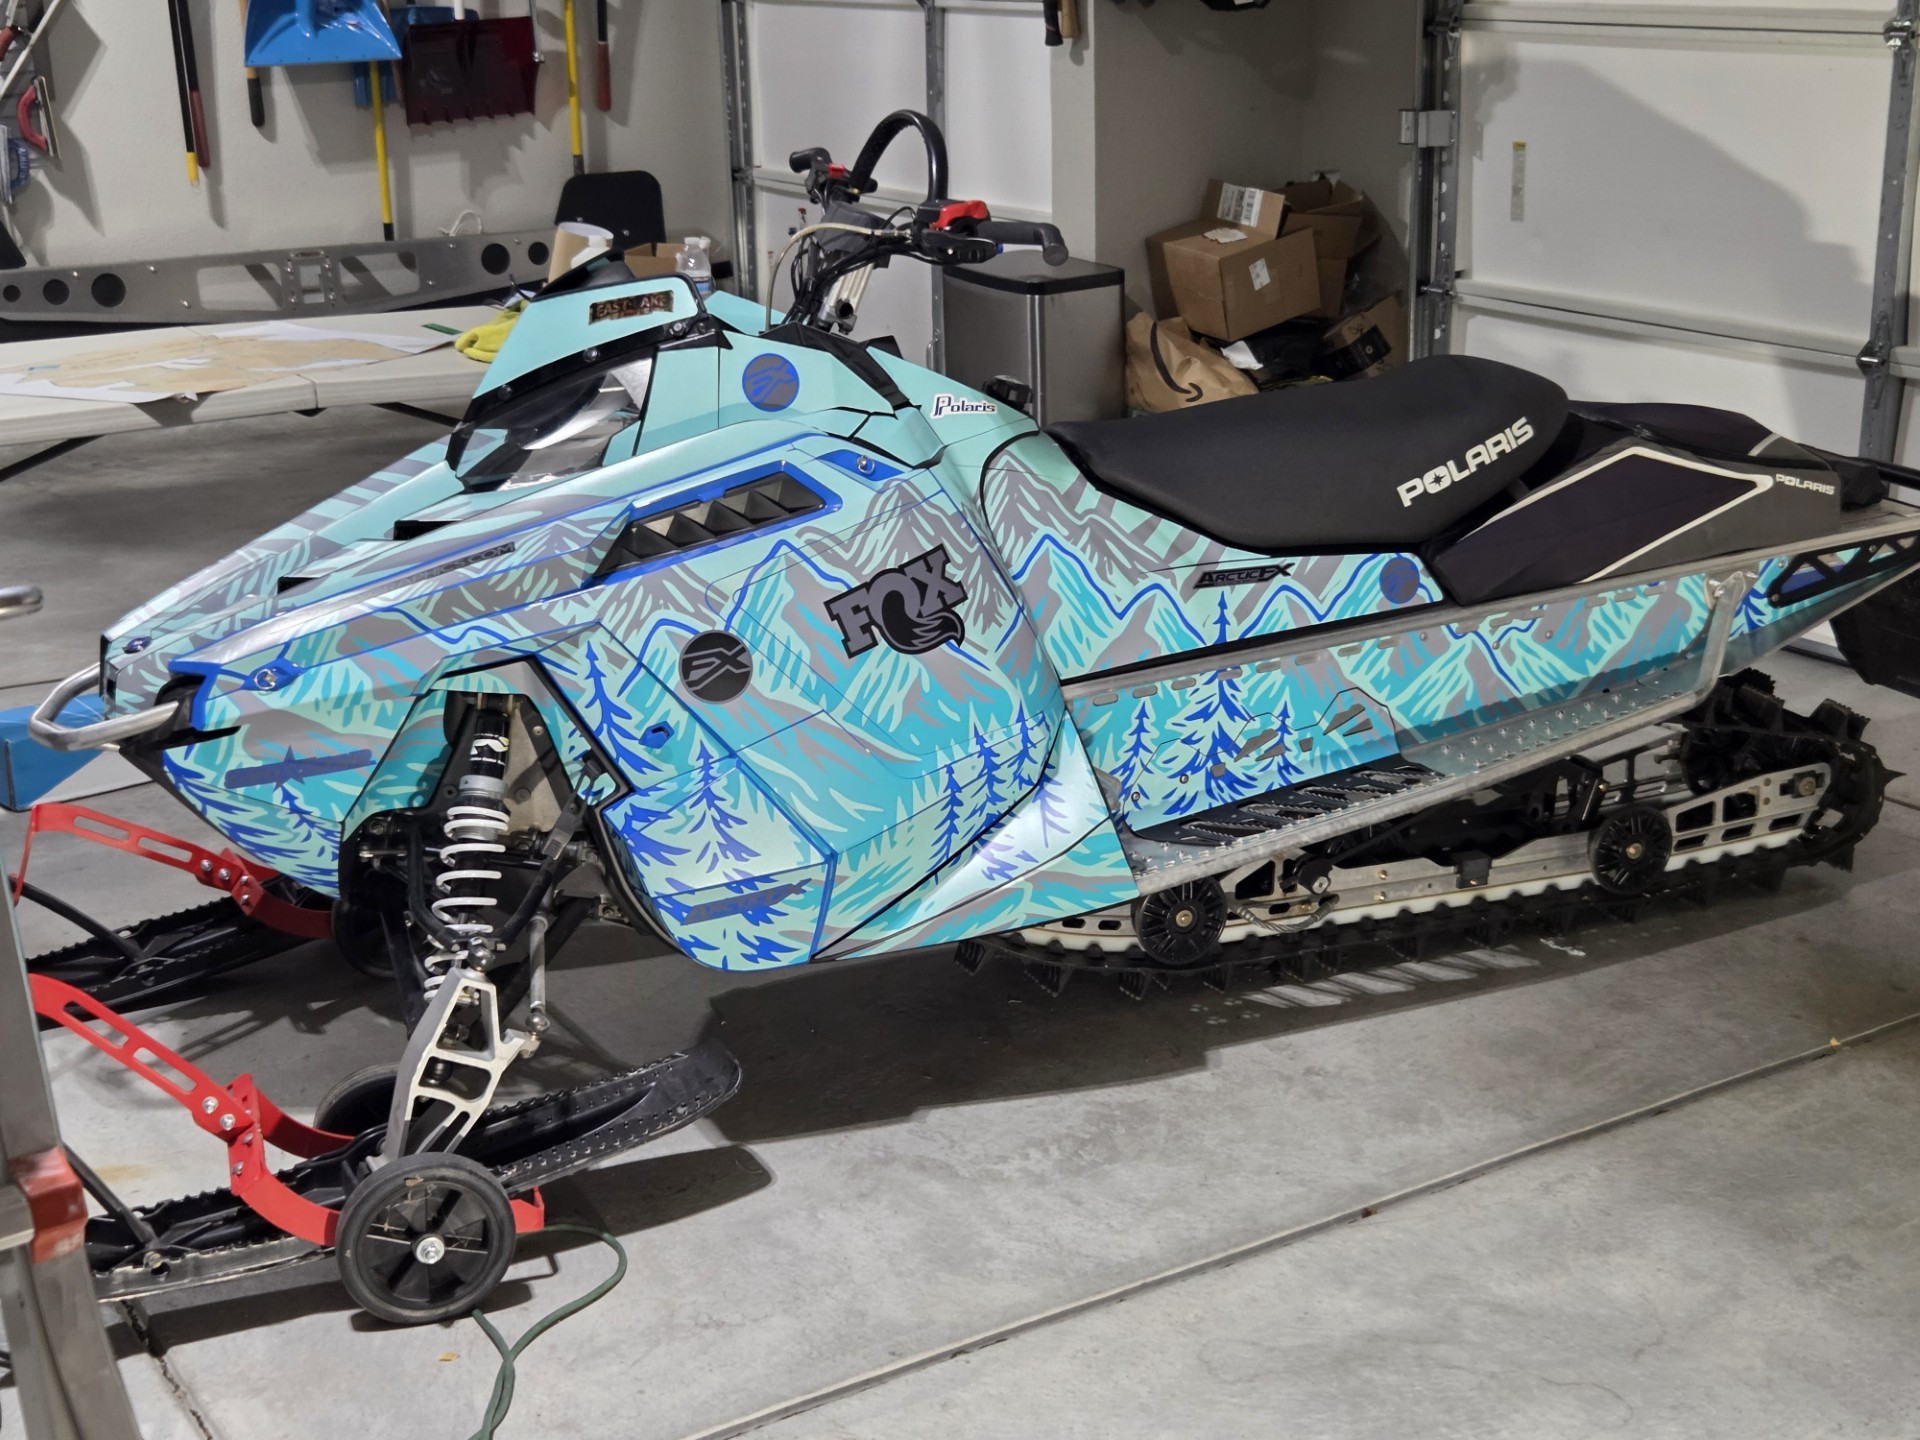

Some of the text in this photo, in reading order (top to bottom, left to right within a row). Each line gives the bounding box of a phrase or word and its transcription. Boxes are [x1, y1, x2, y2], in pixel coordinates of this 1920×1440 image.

[933, 395, 996, 416] Polaris
[1396, 416, 1534, 508] POLARIS
[1775, 473, 1835, 495] POLARIS
[823, 543, 968, 659] FOX
